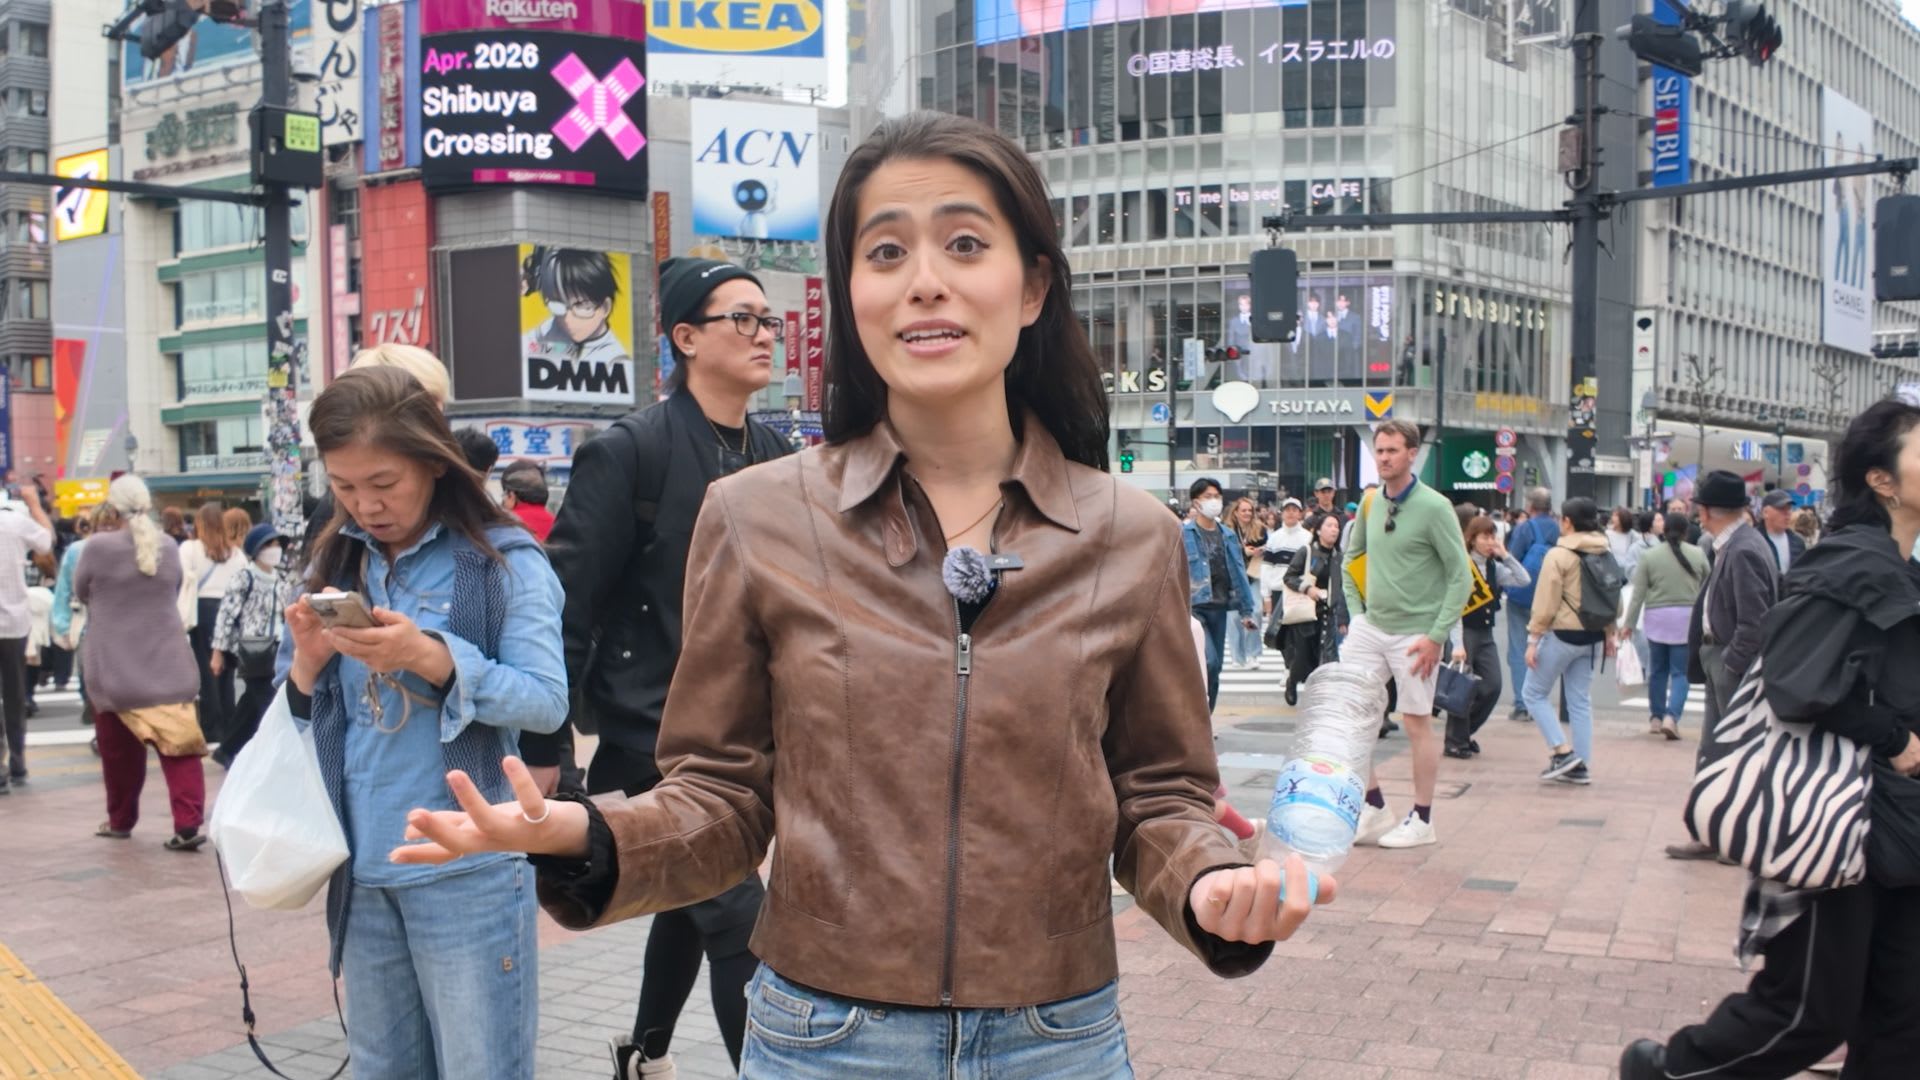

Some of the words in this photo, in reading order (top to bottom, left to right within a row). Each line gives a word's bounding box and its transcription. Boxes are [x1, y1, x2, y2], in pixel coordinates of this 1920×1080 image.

[486, 0, 577, 22] Rakuten
[652, 0, 807, 32] IKEA
[423, 84, 537, 118] Shibuya
[424, 124, 553, 160] Crossing
[1655, 76, 1680, 175] SEIBU
[696, 127, 813, 168] ACN
[1311, 182, 1361, 199] CAFE
[807, 287, 822, 359] カラオケ
[527, 357, 630, 395] DMM
[1269, 399, 1353, 416] TSUTAYA
